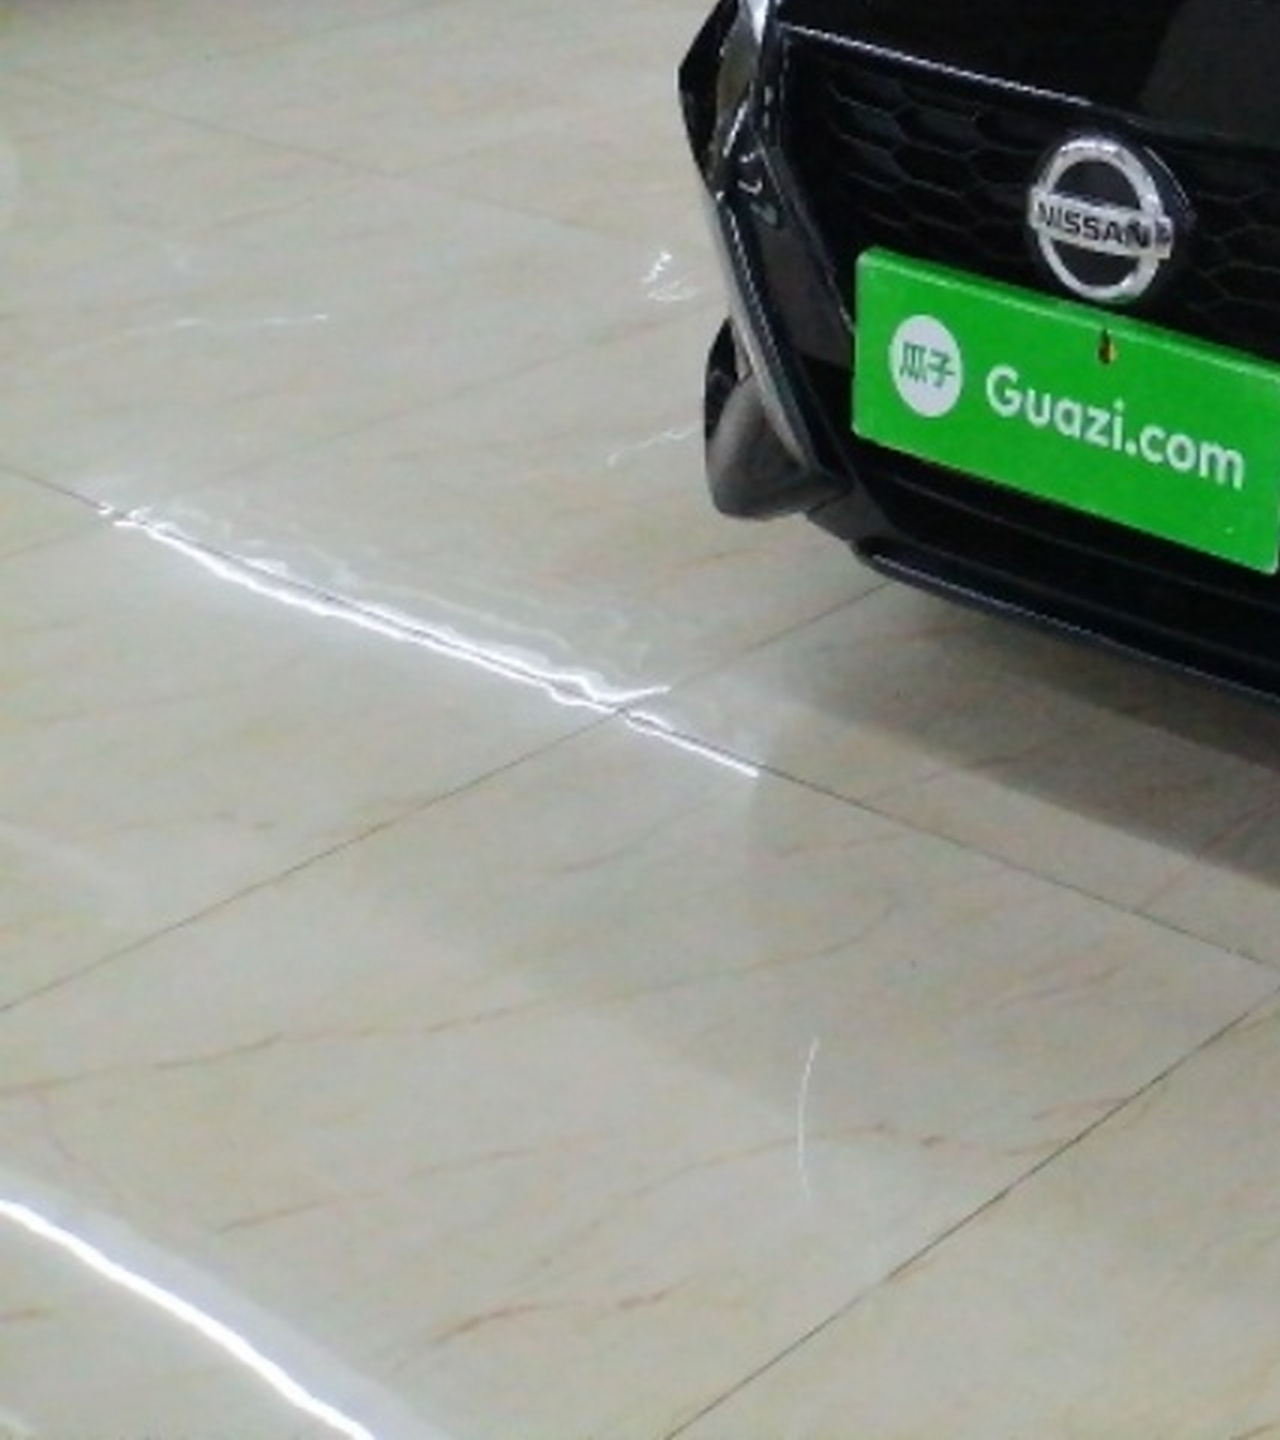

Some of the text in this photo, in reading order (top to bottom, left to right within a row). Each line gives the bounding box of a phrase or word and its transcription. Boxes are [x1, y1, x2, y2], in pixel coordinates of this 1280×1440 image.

[1038, 201, 1151, 248] NISSAN
[898, 340, 955, 389] 瓜子
[985, 364, 1244, 490] Guazi.com
